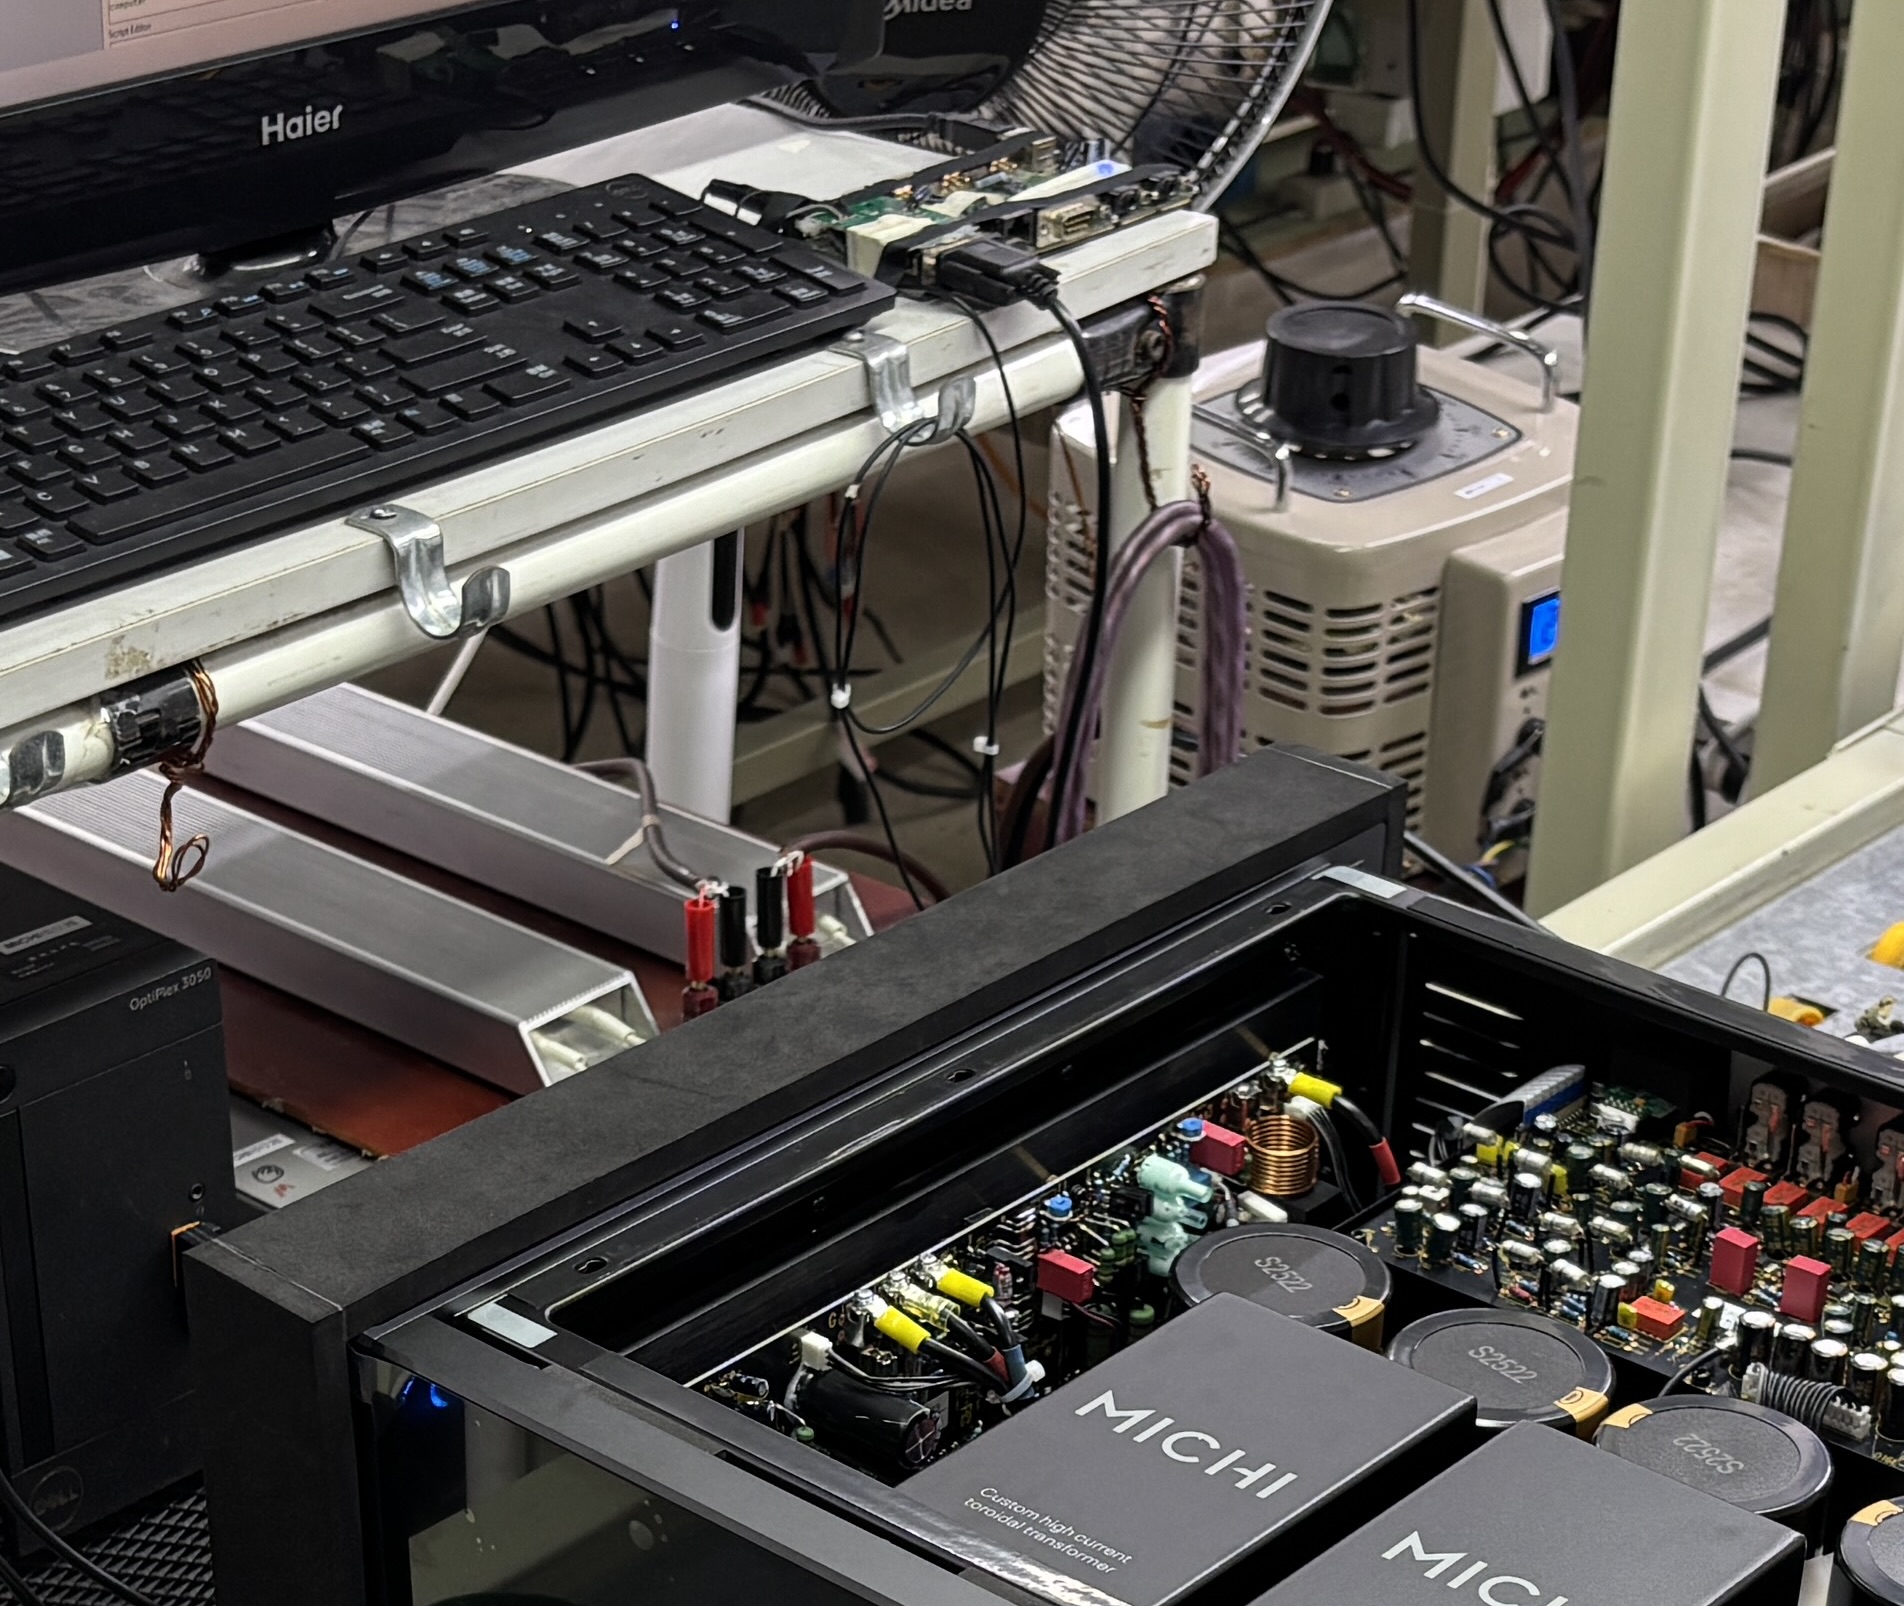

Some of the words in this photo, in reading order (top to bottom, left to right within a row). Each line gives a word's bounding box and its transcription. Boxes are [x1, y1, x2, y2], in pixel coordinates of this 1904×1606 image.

[261, 104, 344, 146] Haier
[128, 982, 180, 1011] OptiPlex
[181, 967, 213, 991] 3050
[1254, 1255, 1314, 1294] S2522
[1467, 1344, 1539, 1385] S2522
[1074, 1389, 1298, 1500] MICHI
[1672, 1432, 1747, 1476] S2522
[964, 1497, 1024, 1533] toroidal
[1023, 1525, 1117, 1576] transformer
[980, 1486, 1041, 1522] Custom
[1039, 1514, 1076, 1539] high
[1075, 1531, 1133, 1565] current
